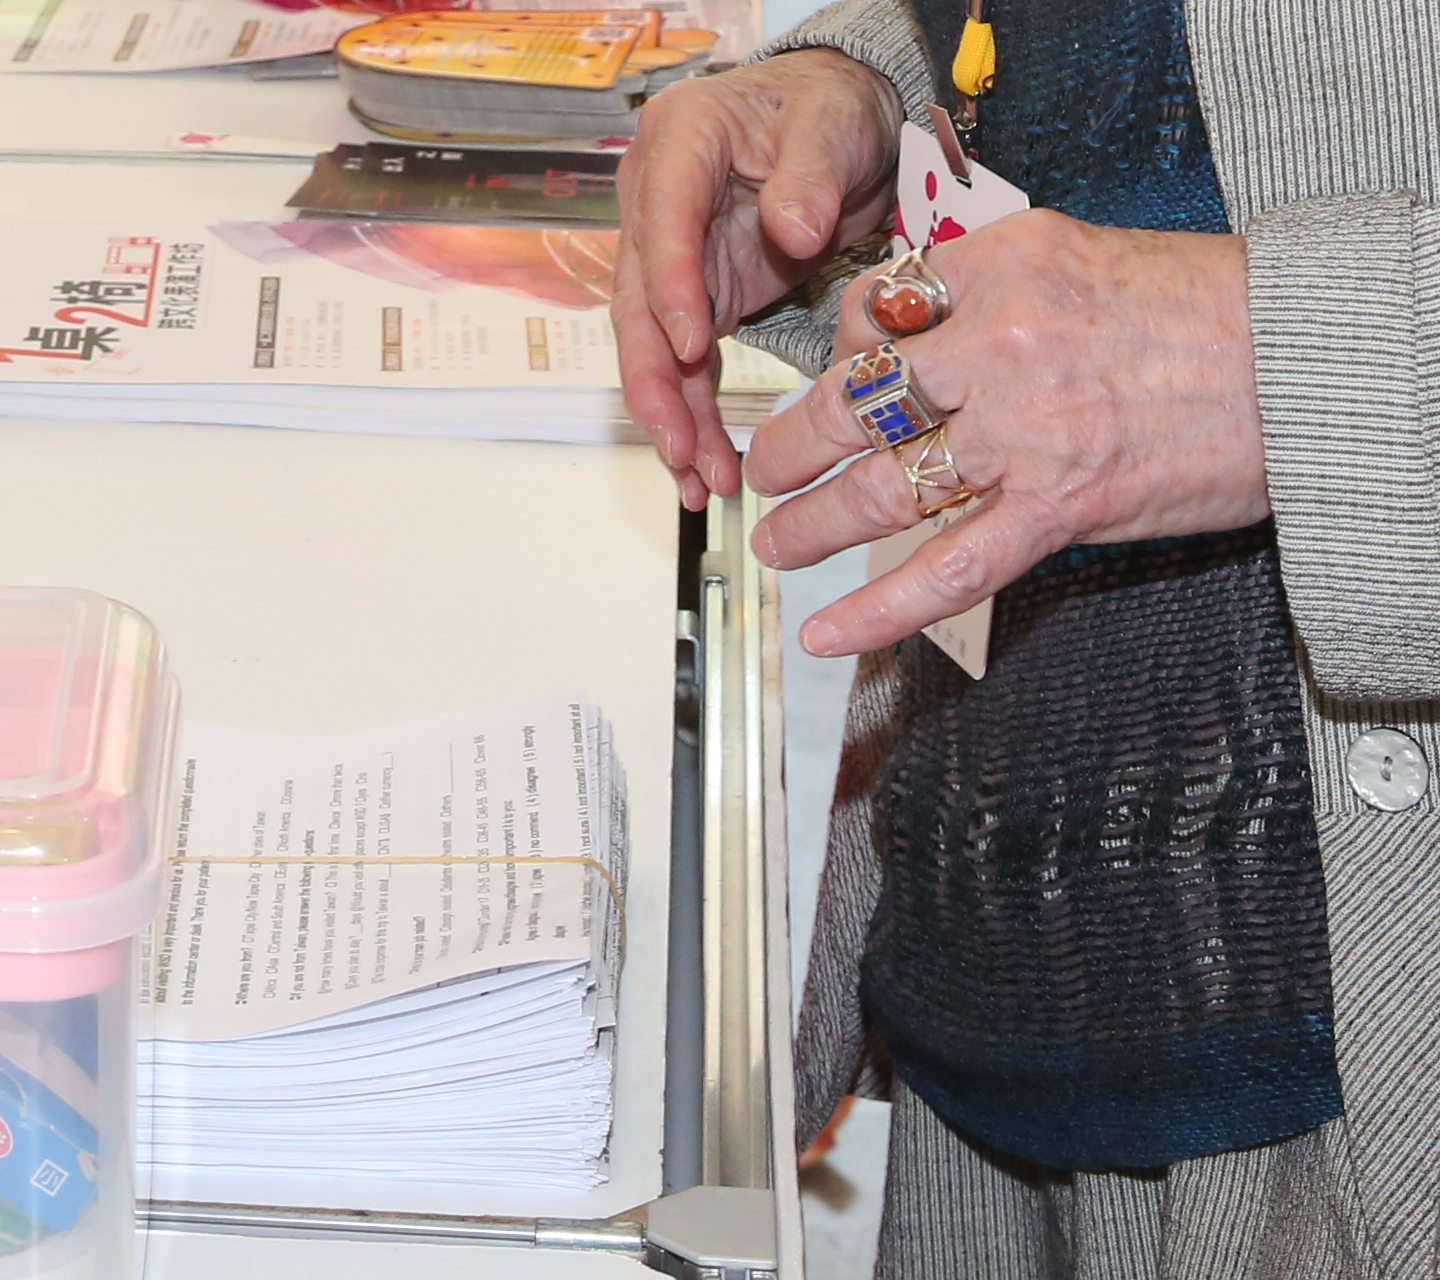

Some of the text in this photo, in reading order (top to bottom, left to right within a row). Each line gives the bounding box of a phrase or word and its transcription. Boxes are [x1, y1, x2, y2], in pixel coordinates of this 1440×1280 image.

[158, 242, 206, 329] 跨文化表演工作坊
[521, 726, 536, 747] strongly
[183, 759, 197, 794] questionnaire
[525, 766, 538, 793] disagree
[178, 795, 193, 822] completed
[196, 879, 210, 889] your
[190, 907, 205, 921] Thank
[296, 916, 310, 931] please
[163, 937, 176, 948] very
[188, 943, 199, 959] center
[293, 953, 305, 964] from
[181, 960, 197, 988] information
[240, 963, 254, 972] you
[158, 969, 172, 986] visiting
[155, 988, 166, 1003] about
[181, 990, 194, 998] the
[36, 1166, 59, 1189] 小
